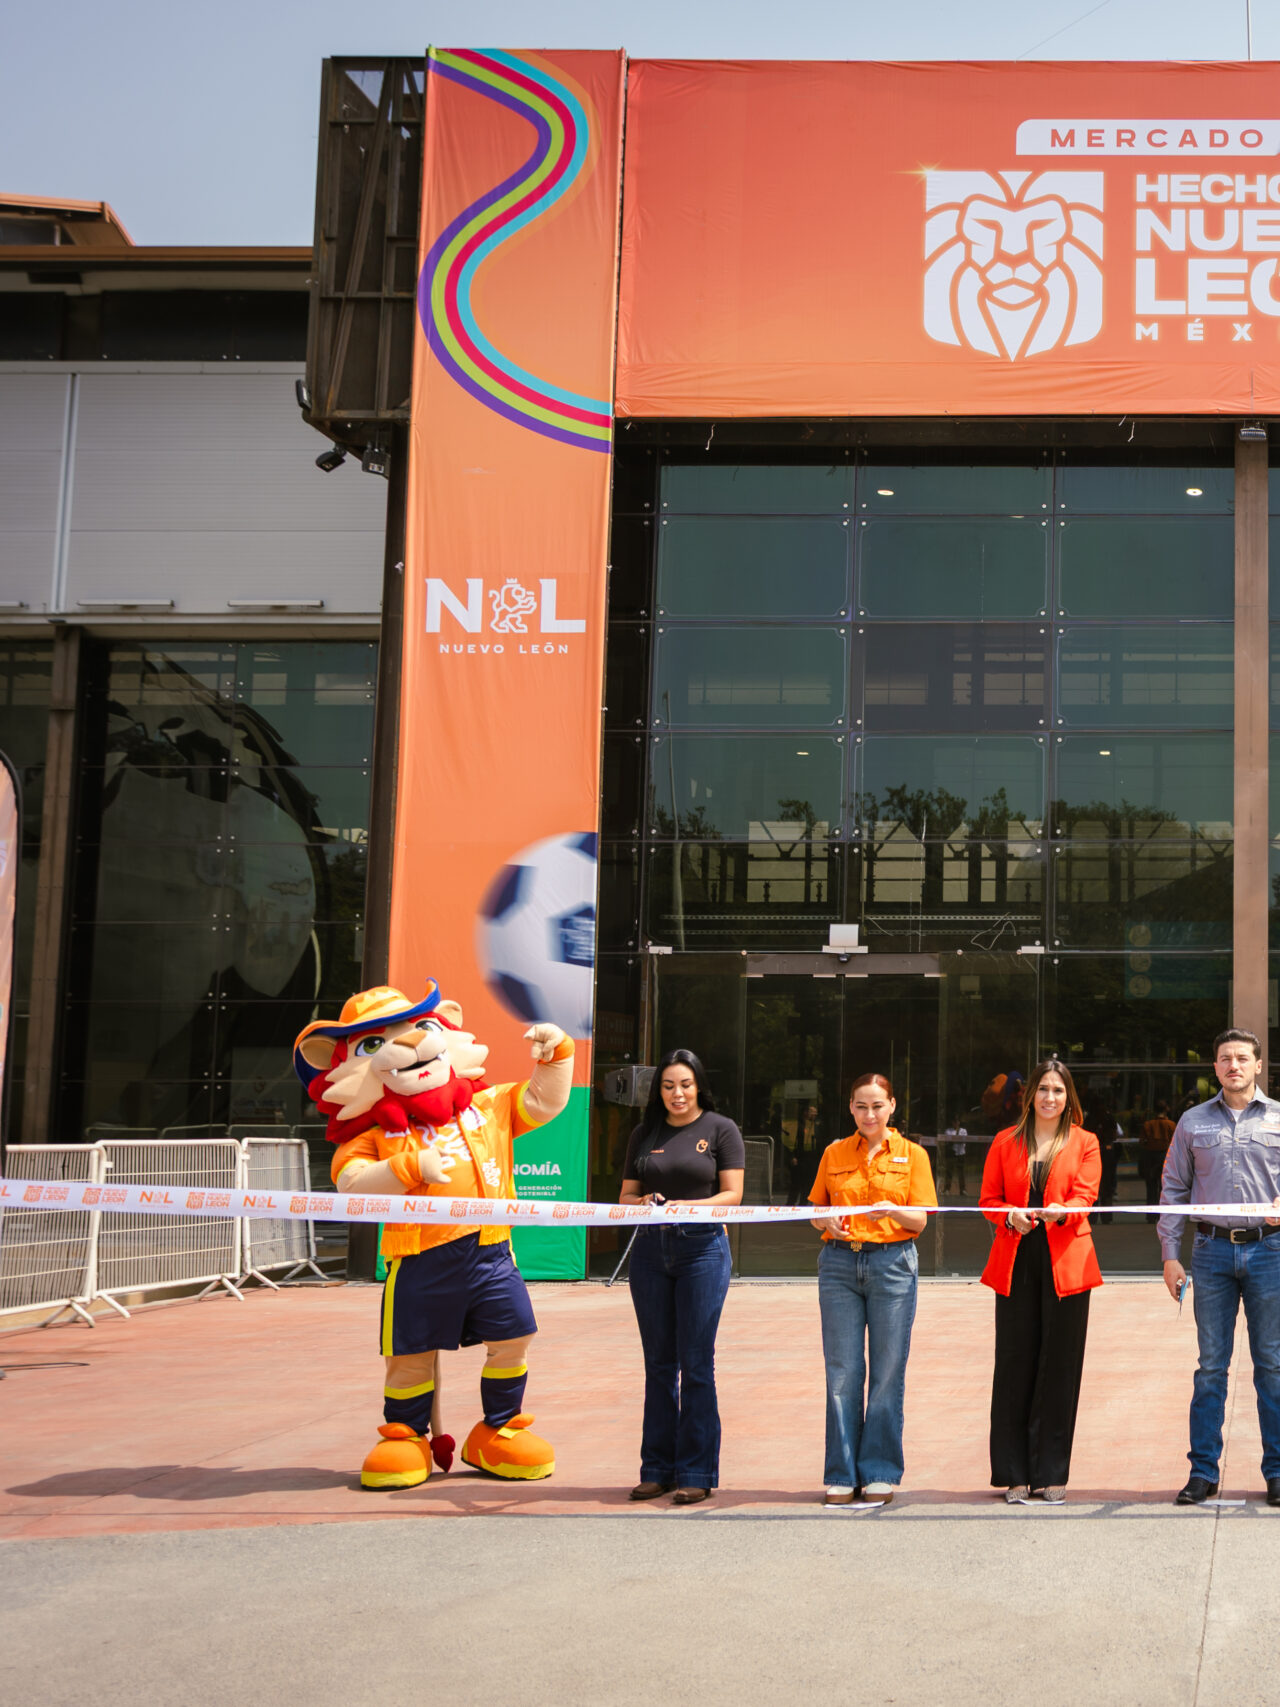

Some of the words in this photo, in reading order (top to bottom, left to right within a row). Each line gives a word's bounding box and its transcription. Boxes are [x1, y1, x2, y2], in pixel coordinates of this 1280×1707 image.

[1050, 128, 1265, 149] MERCADO
[439, 643, 505, 654] NUEVO
[519, 642, 568, 654] LEÓN
[513, 1161, 562, 1176] NOMÍA
